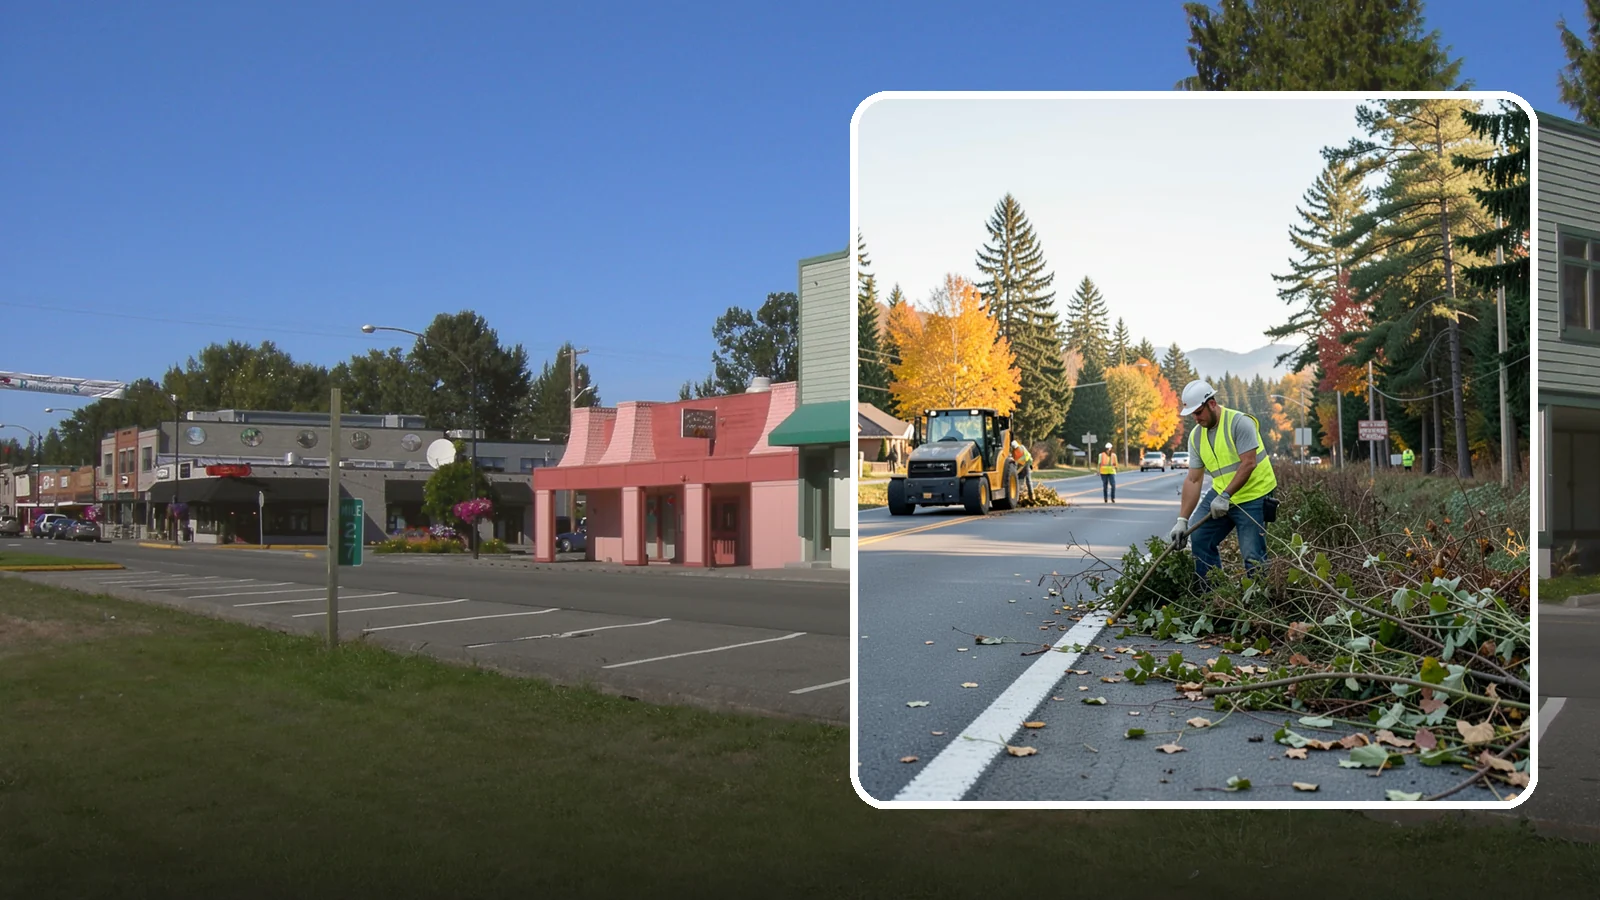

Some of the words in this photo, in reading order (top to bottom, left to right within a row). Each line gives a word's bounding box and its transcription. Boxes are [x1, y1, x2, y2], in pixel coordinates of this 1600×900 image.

[20, 379, 57, 392] Railroad
[341, 505, 362, 517] MILE
[344, 522, 357, 539] 2
[344, 543, 356, 559] 7
